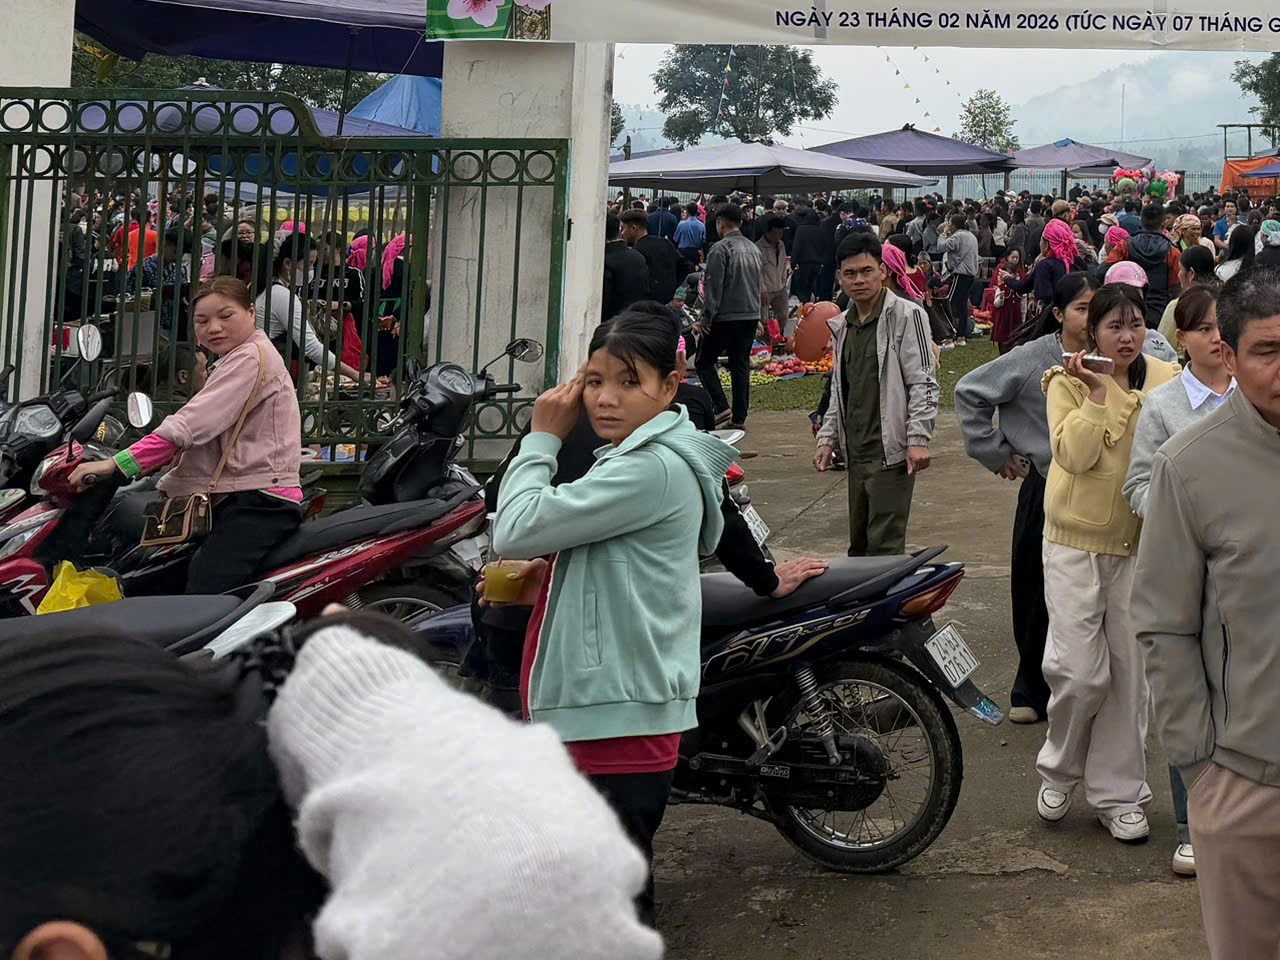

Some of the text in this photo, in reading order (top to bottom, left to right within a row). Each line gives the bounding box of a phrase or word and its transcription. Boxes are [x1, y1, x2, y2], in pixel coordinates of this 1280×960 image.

[776, 6, 834, 27] NGÀY
[838, 12, 861, 28] 23
[866, 8, 933, 28] THÁNG
[938, 13, 960, 29] 02
[966, 9, 1010, 29] NĂM
[1016, 13, 1059, 30] 2026
[1065, 10, 1107, 32] (TỨC
[1112, 11, 1167, 32] NGÀY
[1172, 16, 1194, 31] 07
[1199, 11, 1263, 33] THÁNG
